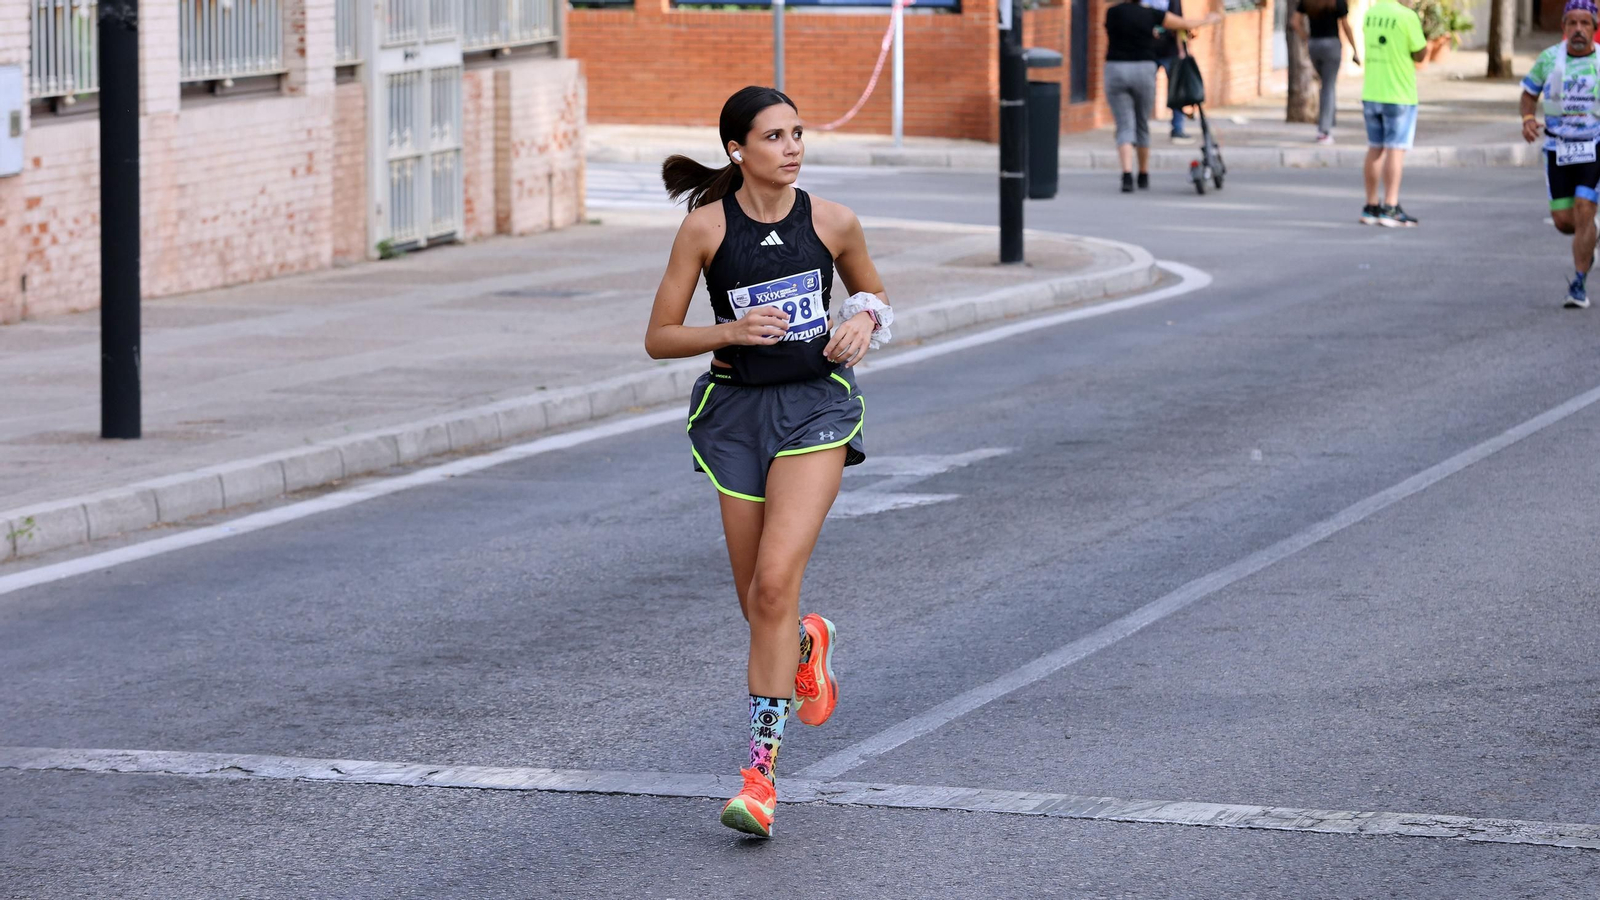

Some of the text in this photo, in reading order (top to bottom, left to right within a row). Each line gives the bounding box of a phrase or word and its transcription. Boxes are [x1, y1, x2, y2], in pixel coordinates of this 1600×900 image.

[757, 291, 781, 304] XXIX
[772, 297, 812, 323] 98
[779, 325, 823, 341] MIZUNO
